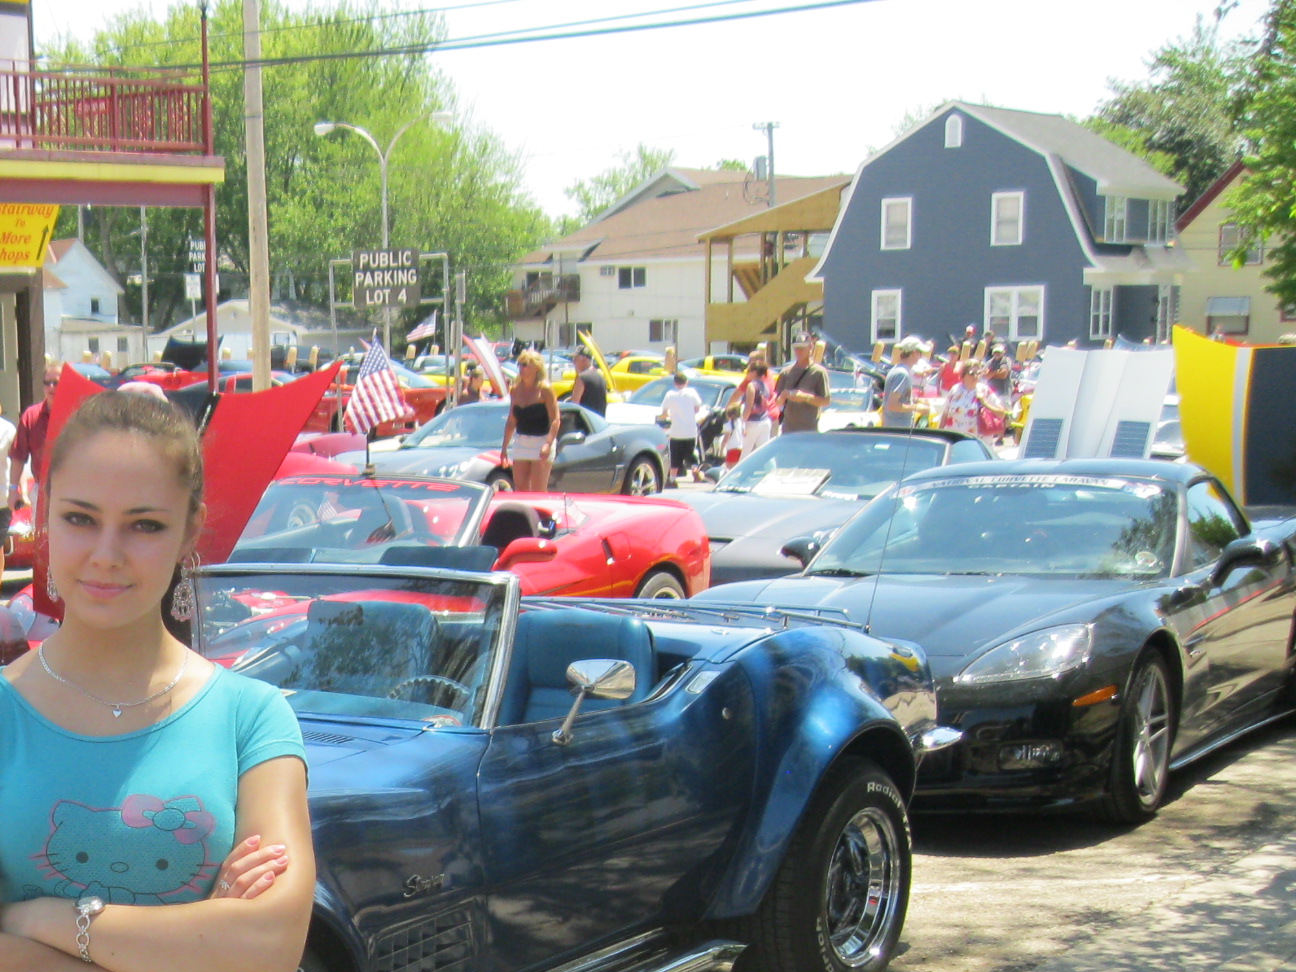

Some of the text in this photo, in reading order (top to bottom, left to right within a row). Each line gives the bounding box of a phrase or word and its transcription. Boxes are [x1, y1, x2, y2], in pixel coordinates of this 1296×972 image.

[0, 232, 32, 245] More
[359, 250, 412, 269] PUBLIC
[355, 268, 417, 288] PARKING
[366, 287, 407, 305] LOT 4
[278, 477, 461, 492] CORVETTE
[867, 781, 902, 808] Radial
